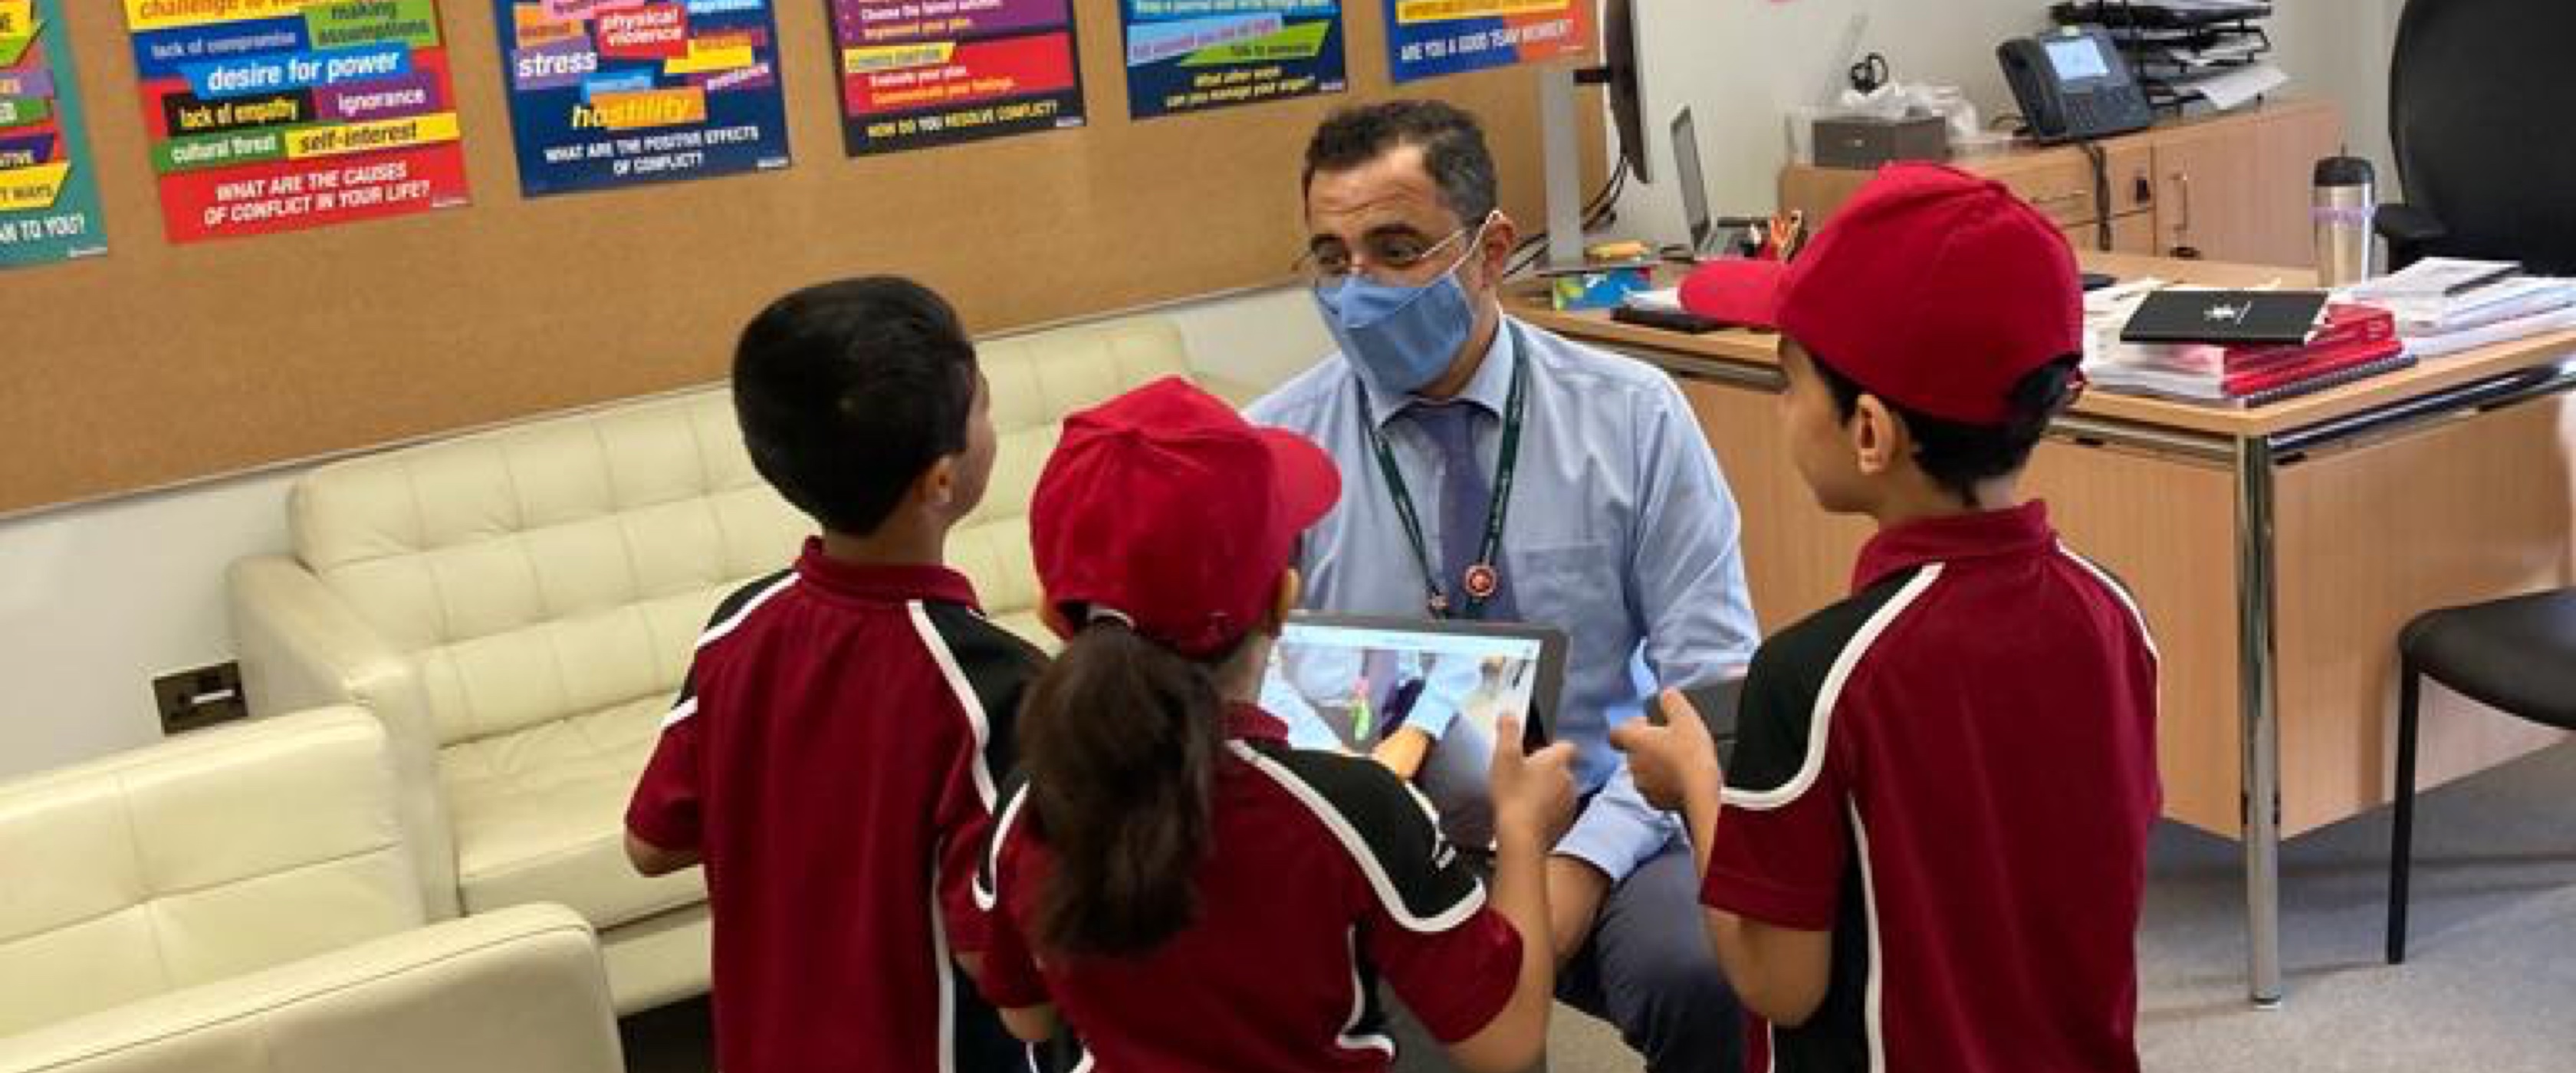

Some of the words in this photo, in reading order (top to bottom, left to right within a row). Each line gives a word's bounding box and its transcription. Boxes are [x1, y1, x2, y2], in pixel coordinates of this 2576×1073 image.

[600, 9, 678, 33] physical
[608, 27, 682, 47] violence
[208, 63, 282, 91] desire
[288, 57, 322, 84] for
[327, 51, 399, 84] power
[518, 51, 598, 78] stress
[180, 107, 214, 129] lack
[216, 104, 232, 123] of
[234, 98, 297, 124] empathy
[338, 87, 425, 114] ignorance
[571, 95, 691, 129] hostility
[298, 122, 416, 154] self-interest
[918, 116, 943, 132] YOU
[171, 139, 228, 163] cultural
[232, 134, 277, 156] threat
[545, 145, 584, 164] WHAT
[586, 142, 614, 159] ARE
[616, 138, 642, 155] THE
[704, 125, 759, 145] EFFECTS
[215, 180, 265, 202] WHAT
[268, 176, 303, 195] ARE
[307, 171, 338, 191] THE
[343, 161, 407, 185] CAUSES
[613, 159, 631, 176] OF
[203, 206, 227, 225] OF
[231, 198, 310, 223] CONFLICT
[317, 193, 336, 210] IN
[338, 188, 383, 207] YOUR
[386, 180, 430, 202] LIFE?
[21, 219, 41, 241] TO
[44, 212, 85, 235] YOU?
